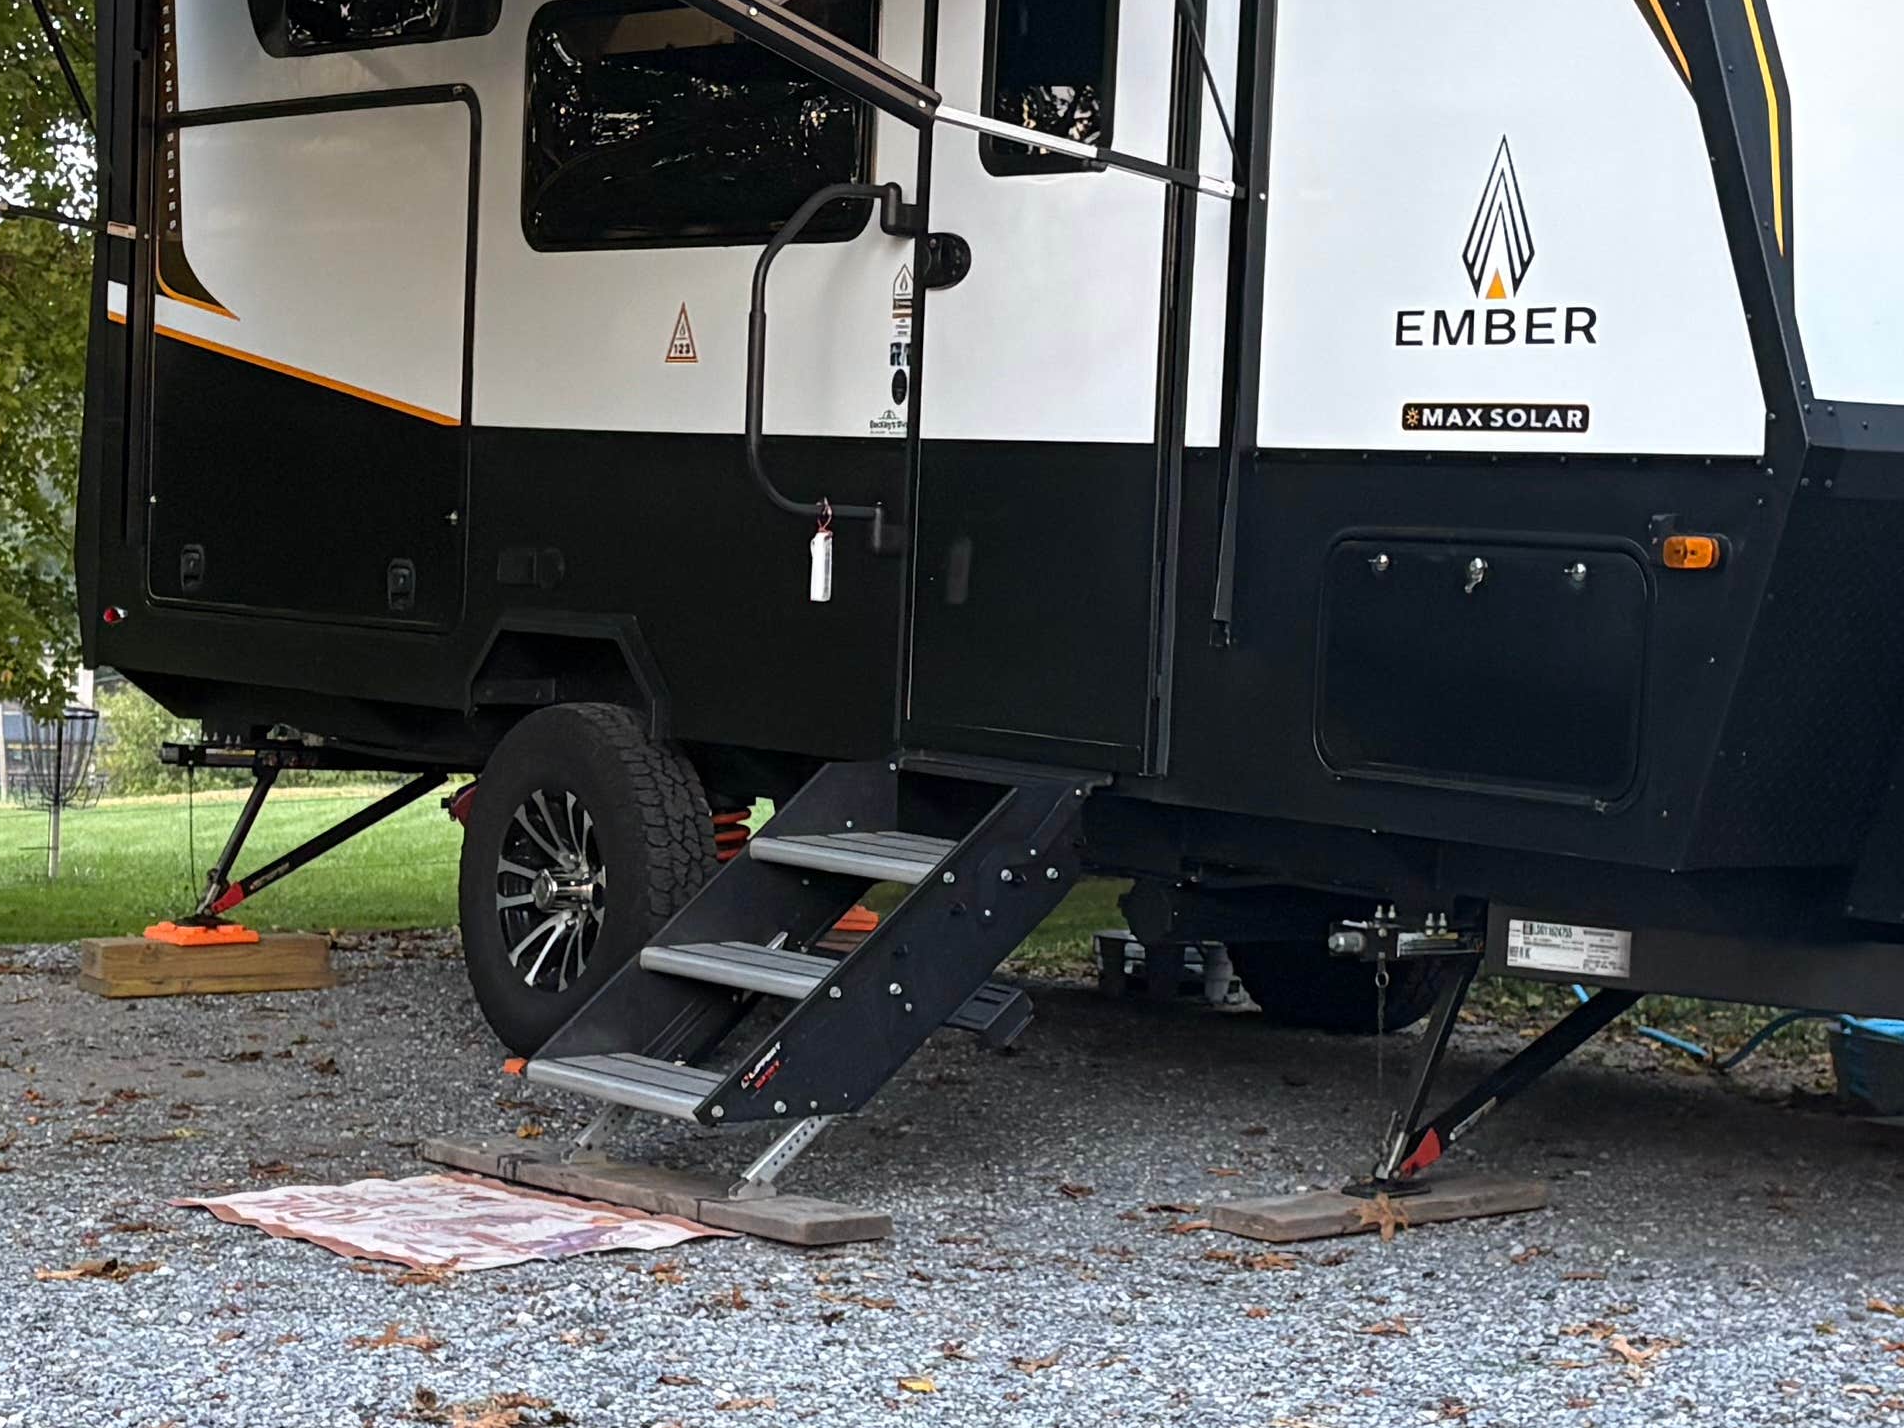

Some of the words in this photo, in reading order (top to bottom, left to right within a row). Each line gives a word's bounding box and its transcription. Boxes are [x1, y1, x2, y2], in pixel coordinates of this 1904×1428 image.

[1395, 306, 1597, 346] EMBER
[1422, 408, 1483, 427] MAX
[1489, 408, 1584, 429] SOLAR
